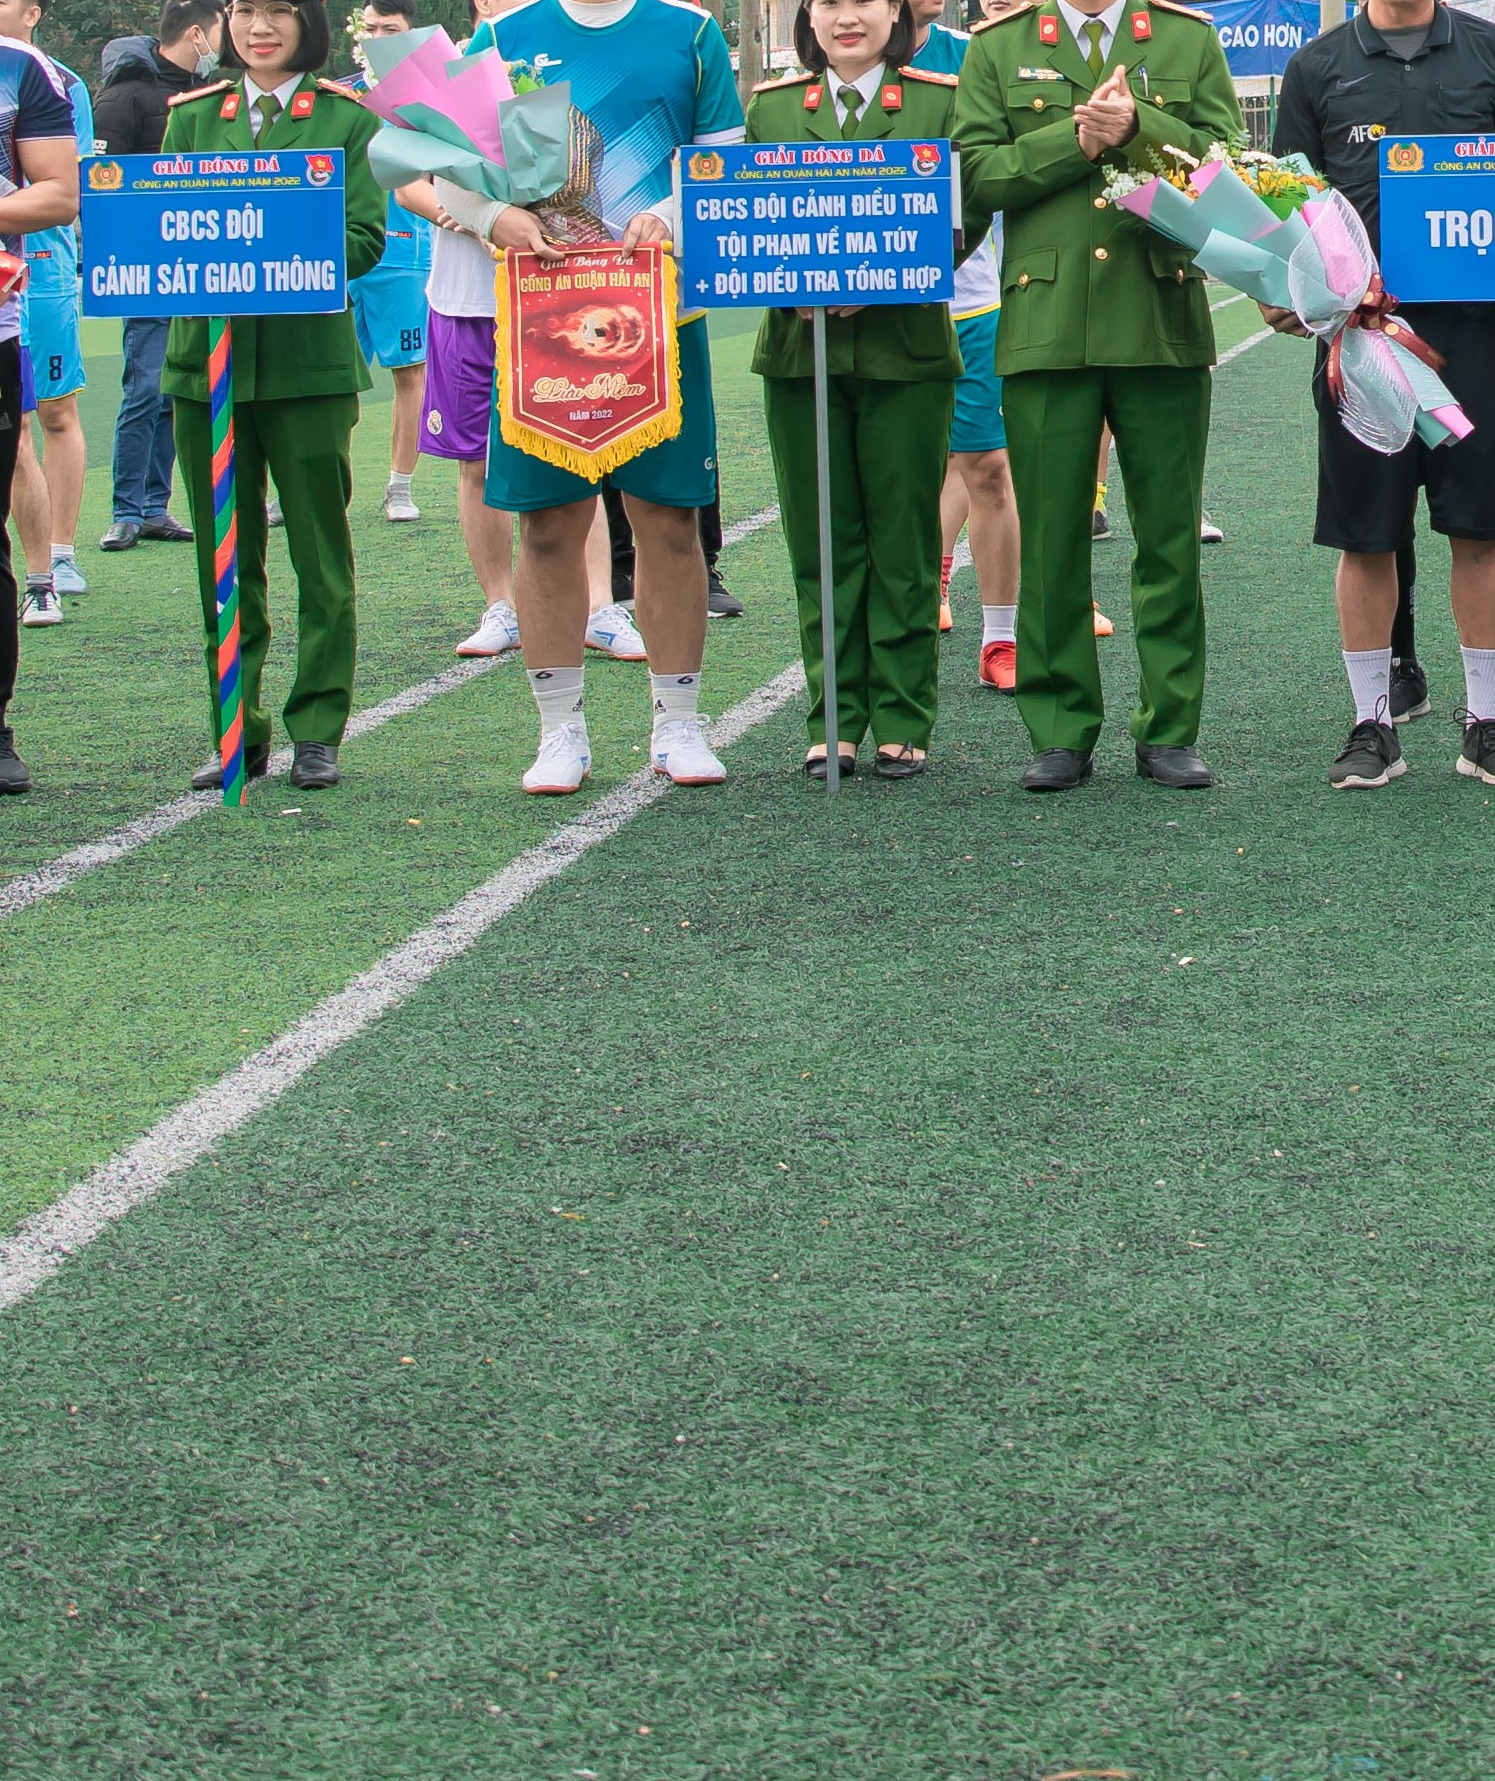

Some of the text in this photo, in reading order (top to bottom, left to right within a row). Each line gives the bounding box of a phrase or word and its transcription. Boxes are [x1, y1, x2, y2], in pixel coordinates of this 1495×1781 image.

[1219, 22, 1303, 48] CAO HƠN
[1347, 124, 1385, 144] AFC
[1455, 137, 1495, 157] GIẢI
[755, 145, 885, 165] GIẢI BÓNG ĐÁ
[696, 187, 938, 223] CBCS ĐỘI CẢNH ĐIỀU TRA
[161, 203, 263, 245] CBCS ĐỘI
[717, 226, 917, 261] TỘI PHẠM VỀ MA TÚY
[92, 255, 335, 296] CẢNH SÁT GIAO THÔNG
[715, 261, 941, 298] ĐỘI ĐIỀU TRA TỔNG HỢP
[400, 327, 422, 352] 89
[49, 355, 63, 381] 8
